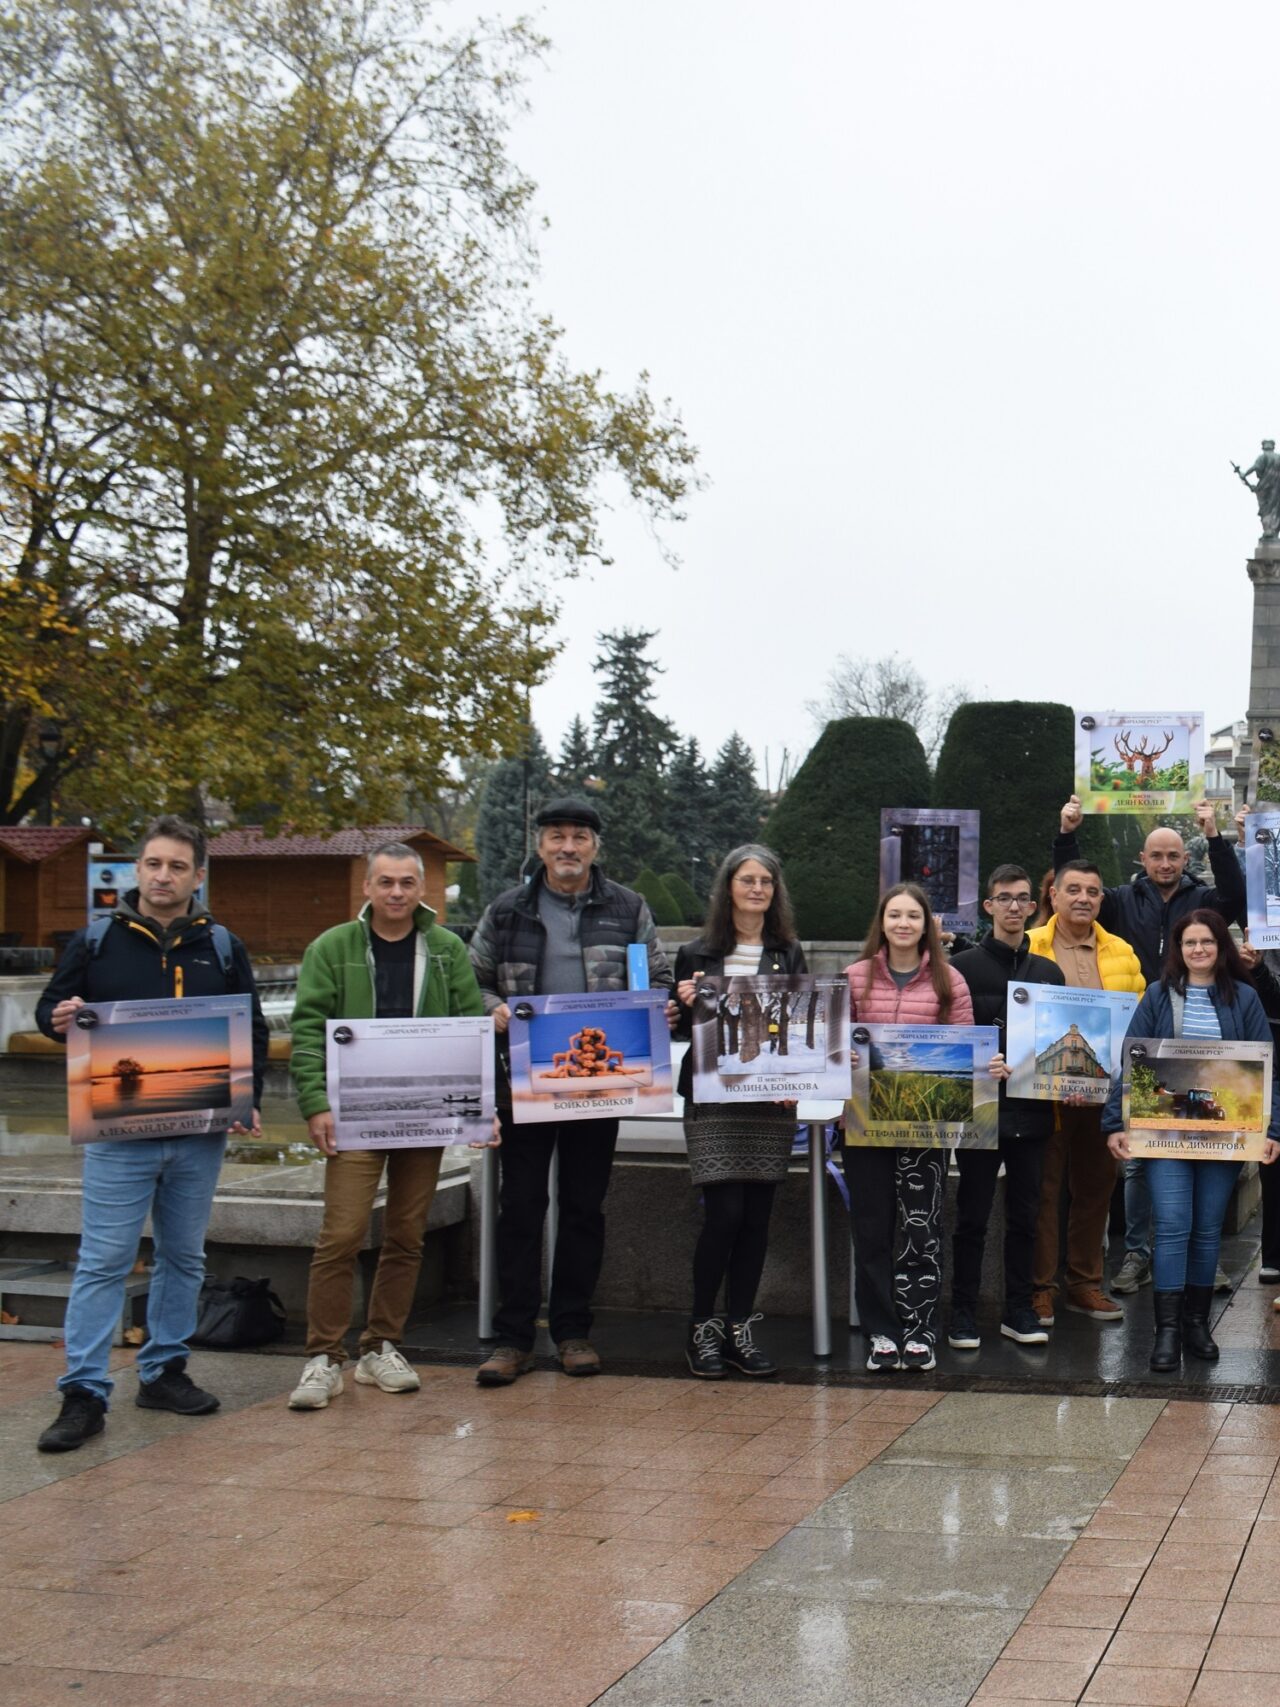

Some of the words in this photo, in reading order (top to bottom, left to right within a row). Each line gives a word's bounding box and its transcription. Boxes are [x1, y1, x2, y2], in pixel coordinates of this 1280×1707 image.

[725, 1083, 769, 1093] ПОЛИНА
[771, 1081, 819, 1091] БОЙКОВА
[1032, 1083, 1051, 1091] ИВО
[554, 1099, 590, 1110] БОЙКО
[592, 1097, 634, 1108] БОЙКОВ
[97, 1122, 176, 1138] АЛЕКСАНДЪР
[179, 1118, 228, 1130] АНДРЕЕВ
[360, 1129, 405, 1139] СТЕФАН
[405, 1127, 464, 1138] СТЕФАНОВ
[863, 1129, 910, 1138] СТЕФАНИ
[912, 1129, 979, 1140] ПАНАЙОТОВА
[1145, 1140, 1185, 1150] ДЕНИЦА
[1186, 1141, 1245, 1151] ДИМИТРОВА
